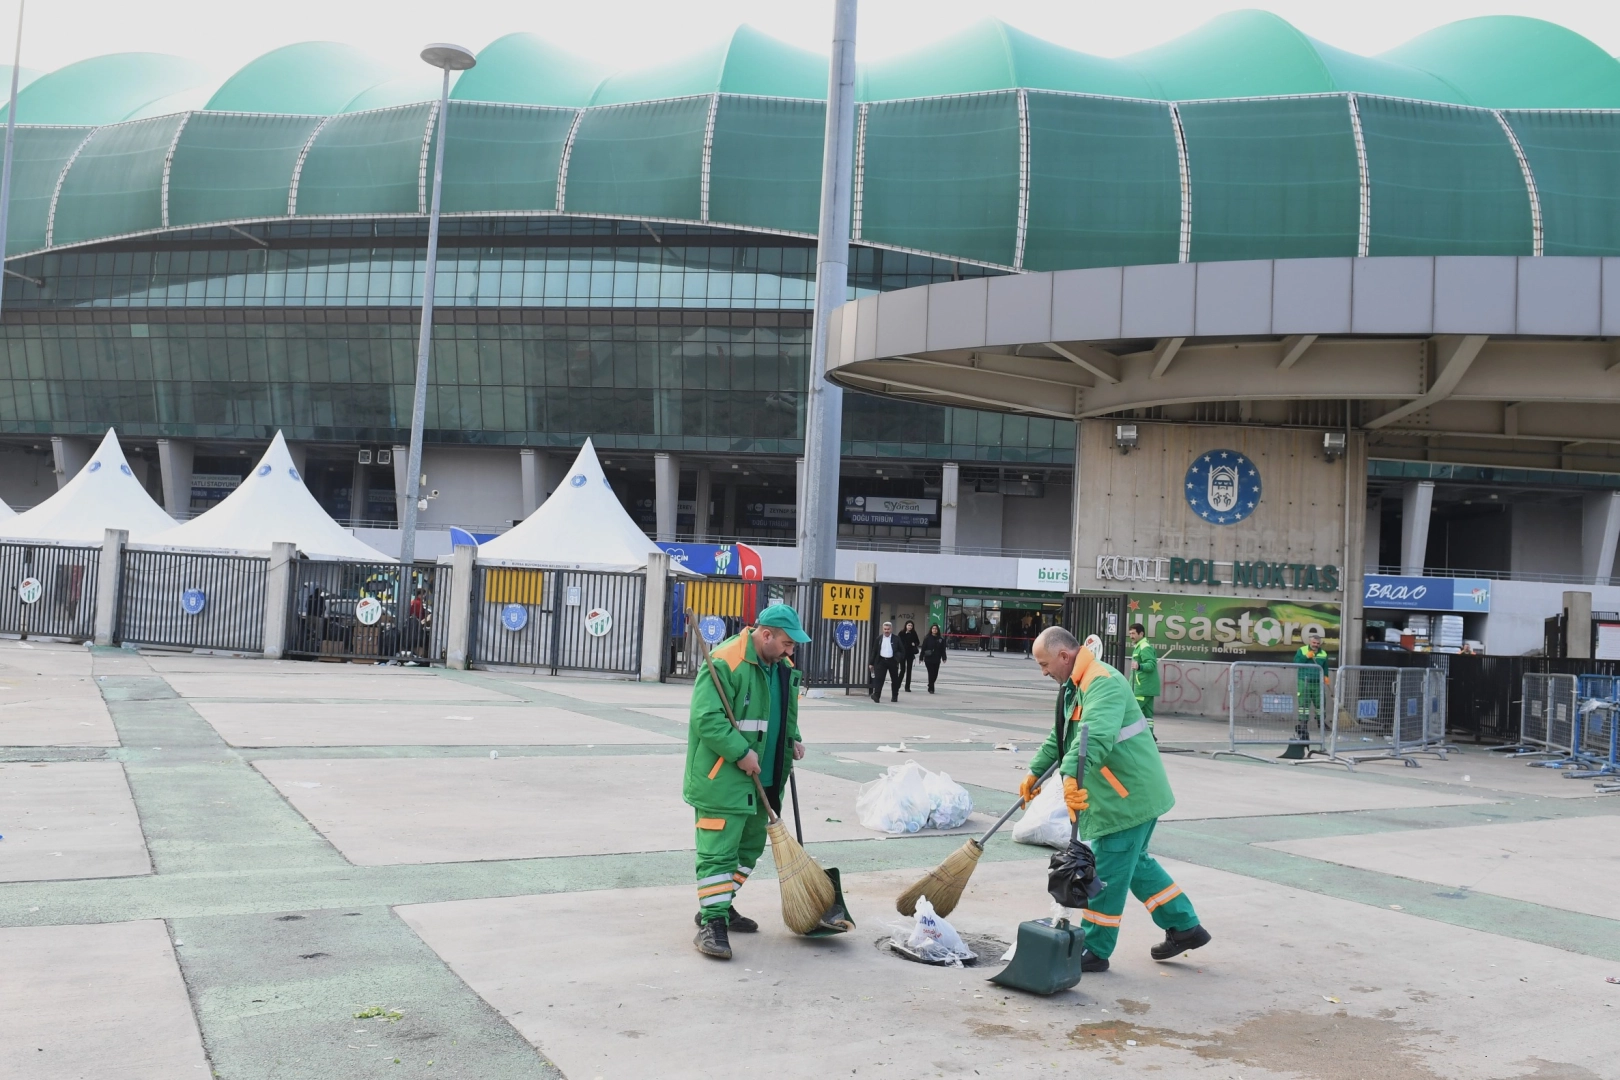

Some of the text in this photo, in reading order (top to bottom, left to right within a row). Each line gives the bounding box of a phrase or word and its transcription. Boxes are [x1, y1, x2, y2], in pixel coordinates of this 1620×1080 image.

[852, 514, 870, 522] DOĞU
[1038, 569, 1069, 580] burs
[1096, 555, 1221, 586] KONTROL
[830, 586, 864, 603] ÇIKIŞ
[833, 604, 861, 616] EXIT
[1170, 641, 1209, 654] alışveriş
[1212, 644, 1246, 655] noktası
[1161, 663, 1202, 704] BS
